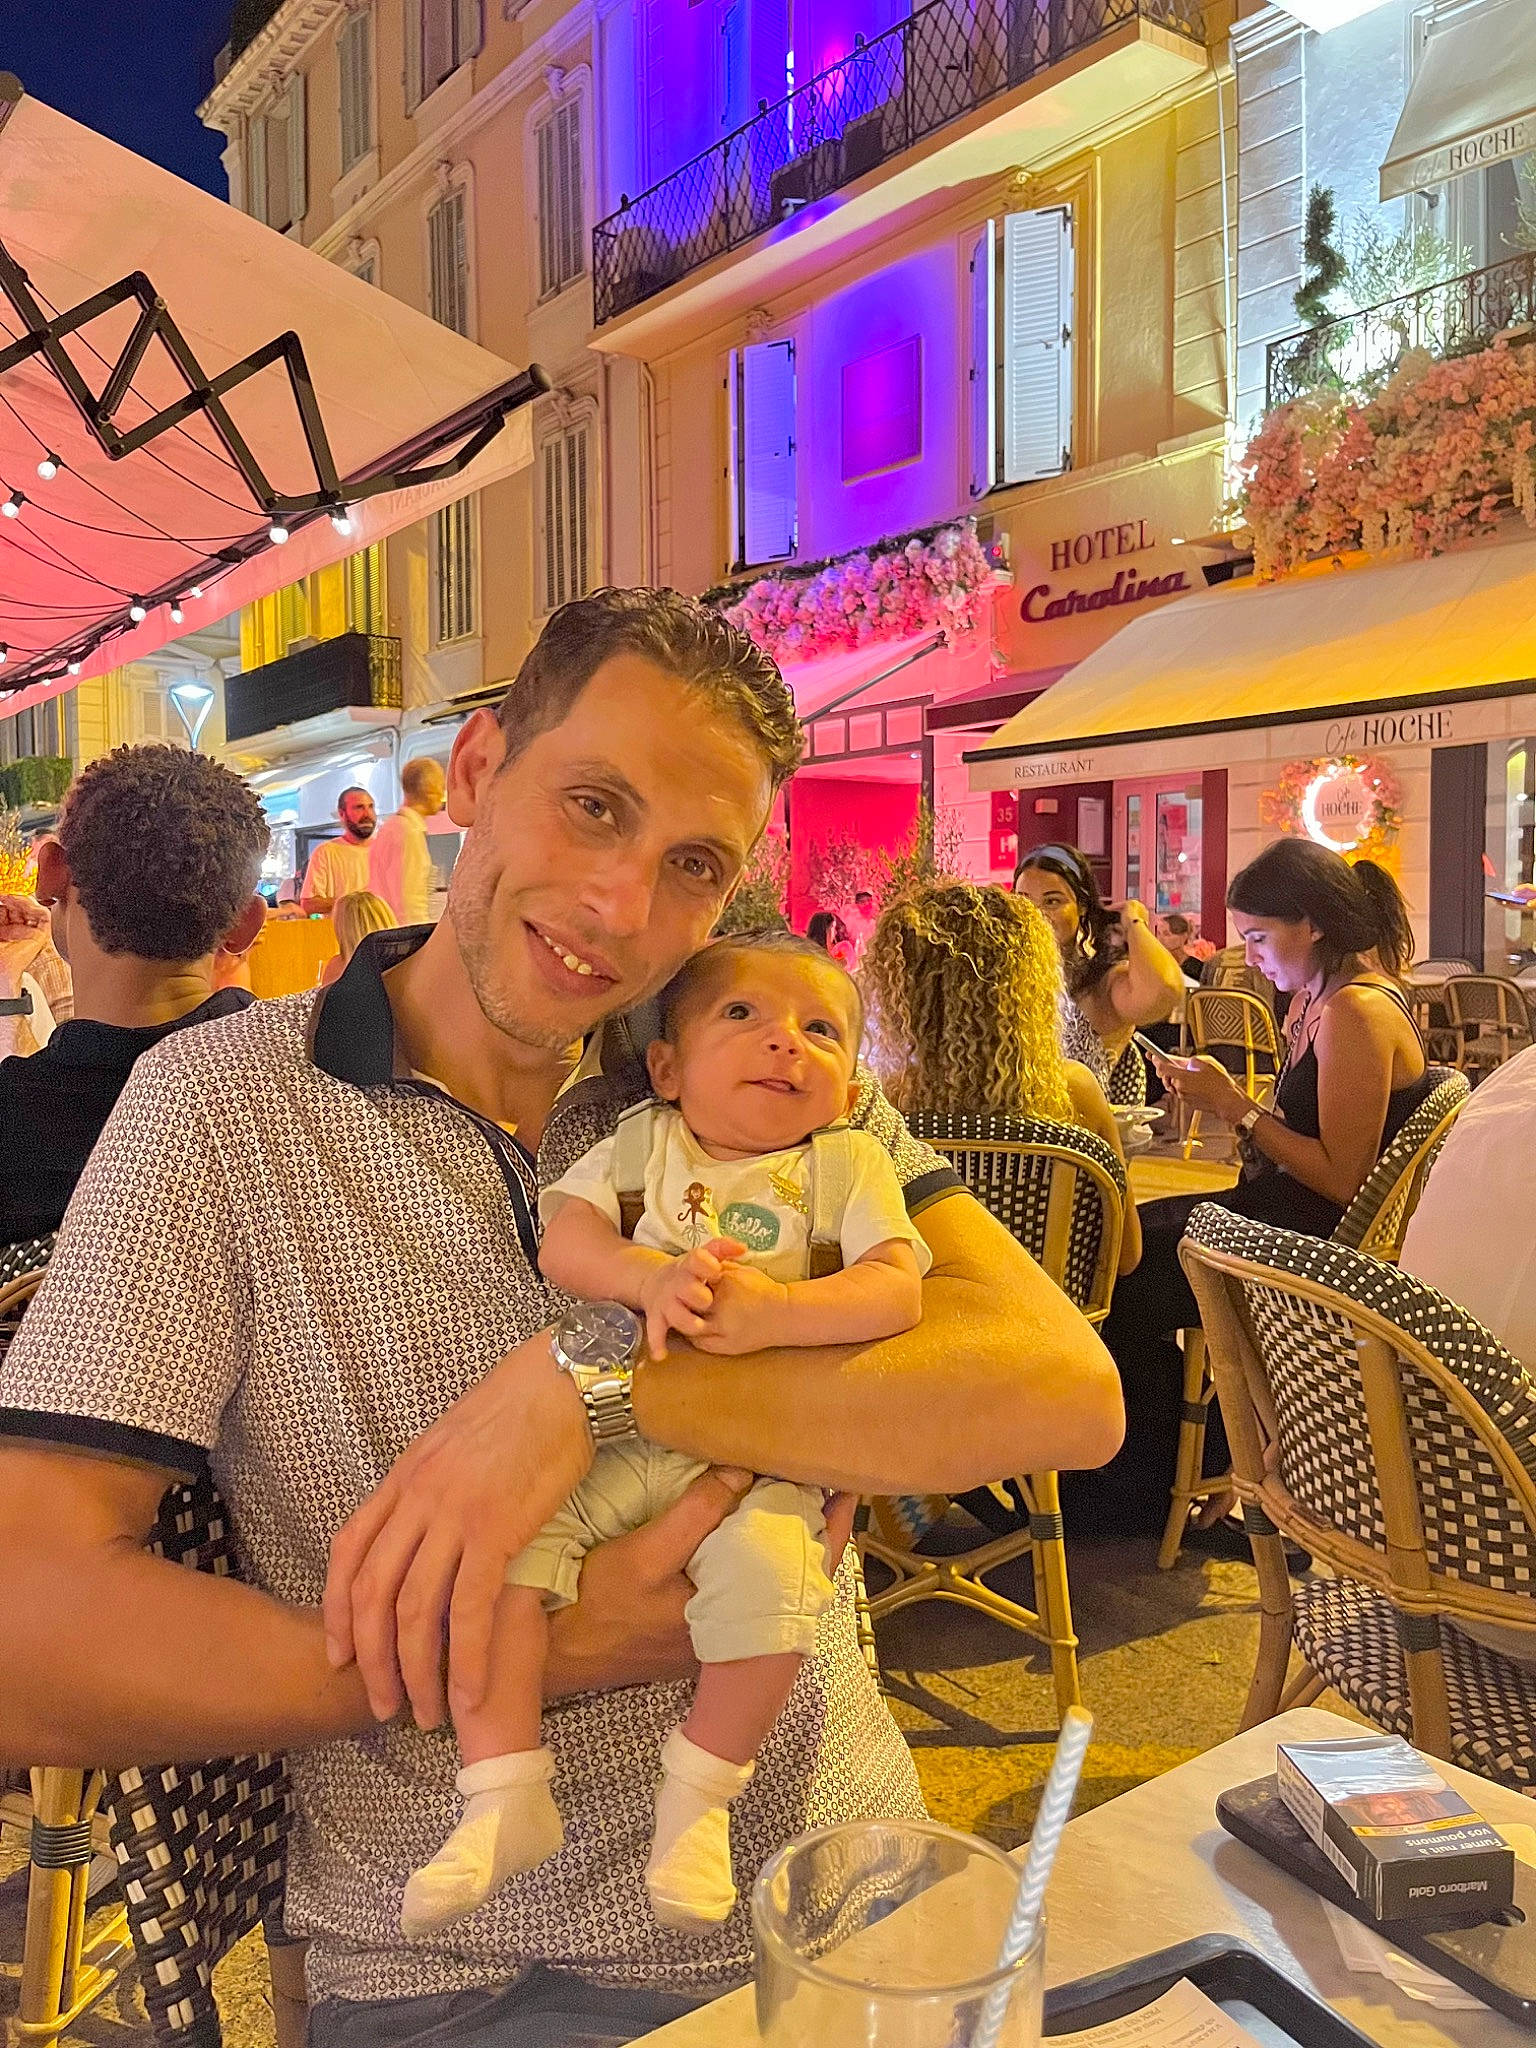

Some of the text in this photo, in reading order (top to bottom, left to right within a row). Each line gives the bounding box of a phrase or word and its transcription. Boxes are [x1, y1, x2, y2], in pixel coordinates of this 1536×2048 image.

[1449, 122, 1525, 171] HOCHE
[1049, 518, 1156, 572] HOTEL
[1020, 568, 1192, 623] Carolina
[1362, 709, 1454, 747] HOCHE
[1014, 759, 1095, 779] RESTAURANT
[996, 806, 1013, 823] 35
[1321, 800, 1363, 817] HOCHE
[1404, 1827, 1493, 1847] vos poumons
[1460, 1837, 1503, 1850] Fumer
[1431, 1844, 1458, 1854] nuit
[1408, 1880, 1488, 1898] Marlboro Gold
